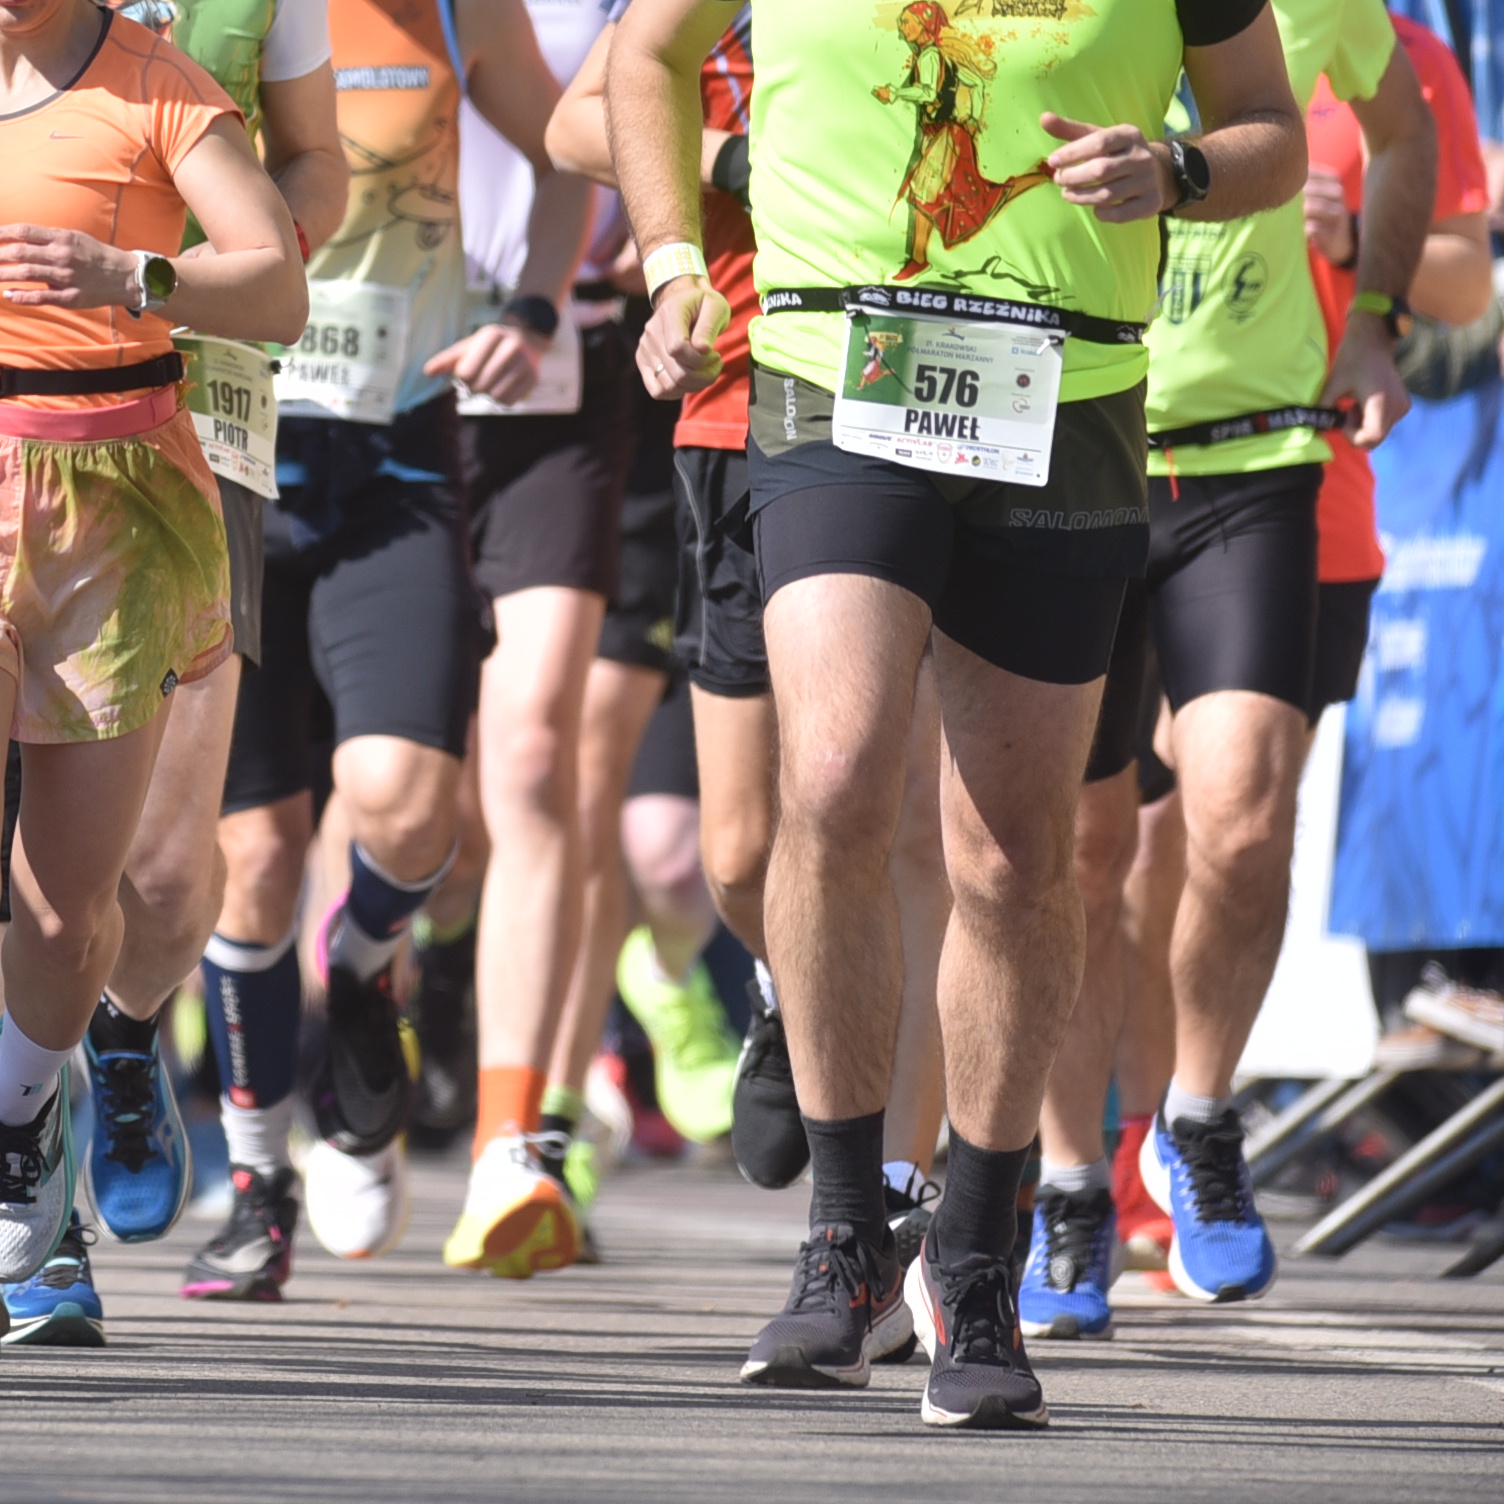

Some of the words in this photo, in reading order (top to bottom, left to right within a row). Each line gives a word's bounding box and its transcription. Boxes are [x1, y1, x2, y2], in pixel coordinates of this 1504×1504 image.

[936, 341, 977, 353] KRAKOWSKI
[955, 353, 994, 363] MARZANNY
[207, 379, 251, 423] 1917
[914, 364, 980, 408] 576
[214, 419, 248, 452] PIOTR
[904, 408, 982, 441] PAWEŁ
